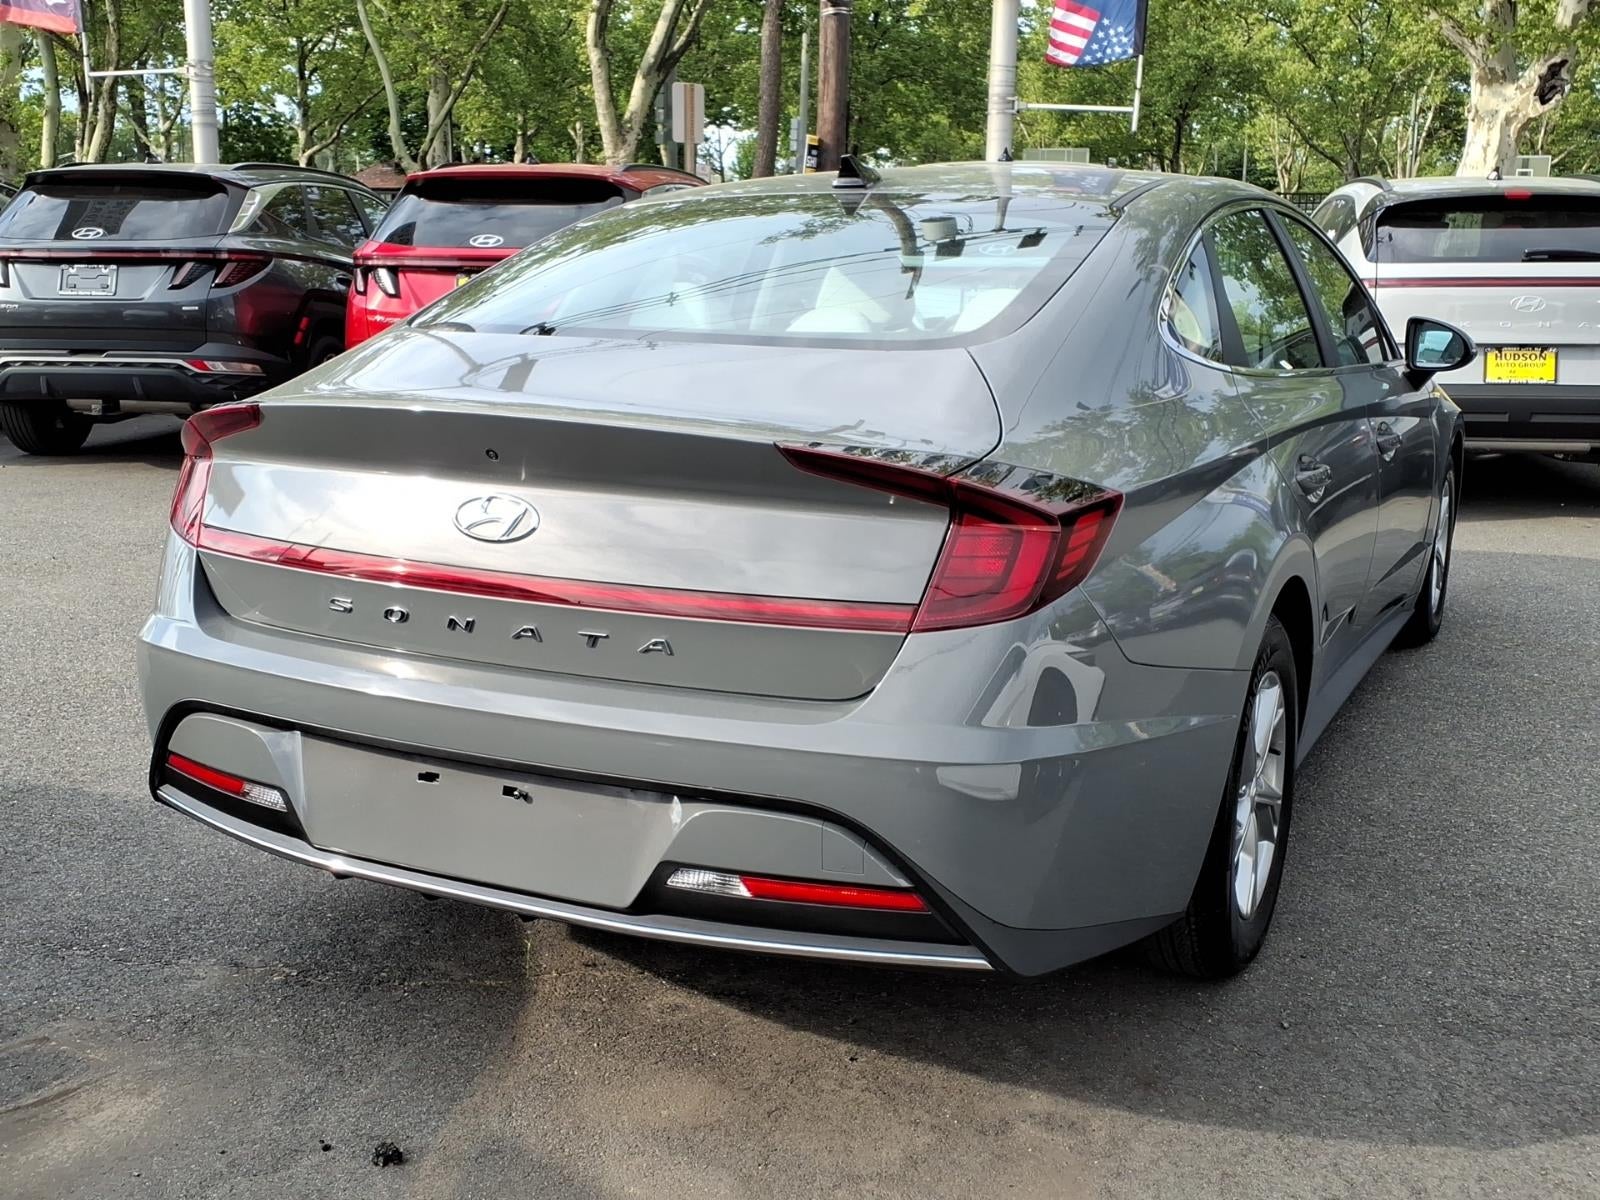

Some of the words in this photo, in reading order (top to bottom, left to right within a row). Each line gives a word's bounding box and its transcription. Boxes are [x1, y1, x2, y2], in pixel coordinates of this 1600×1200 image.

[1460, 321, 1593, 329] KONA
[1495, 352, 1547, 361] HUDSON
[328, 597, 675, 657] SONATA
